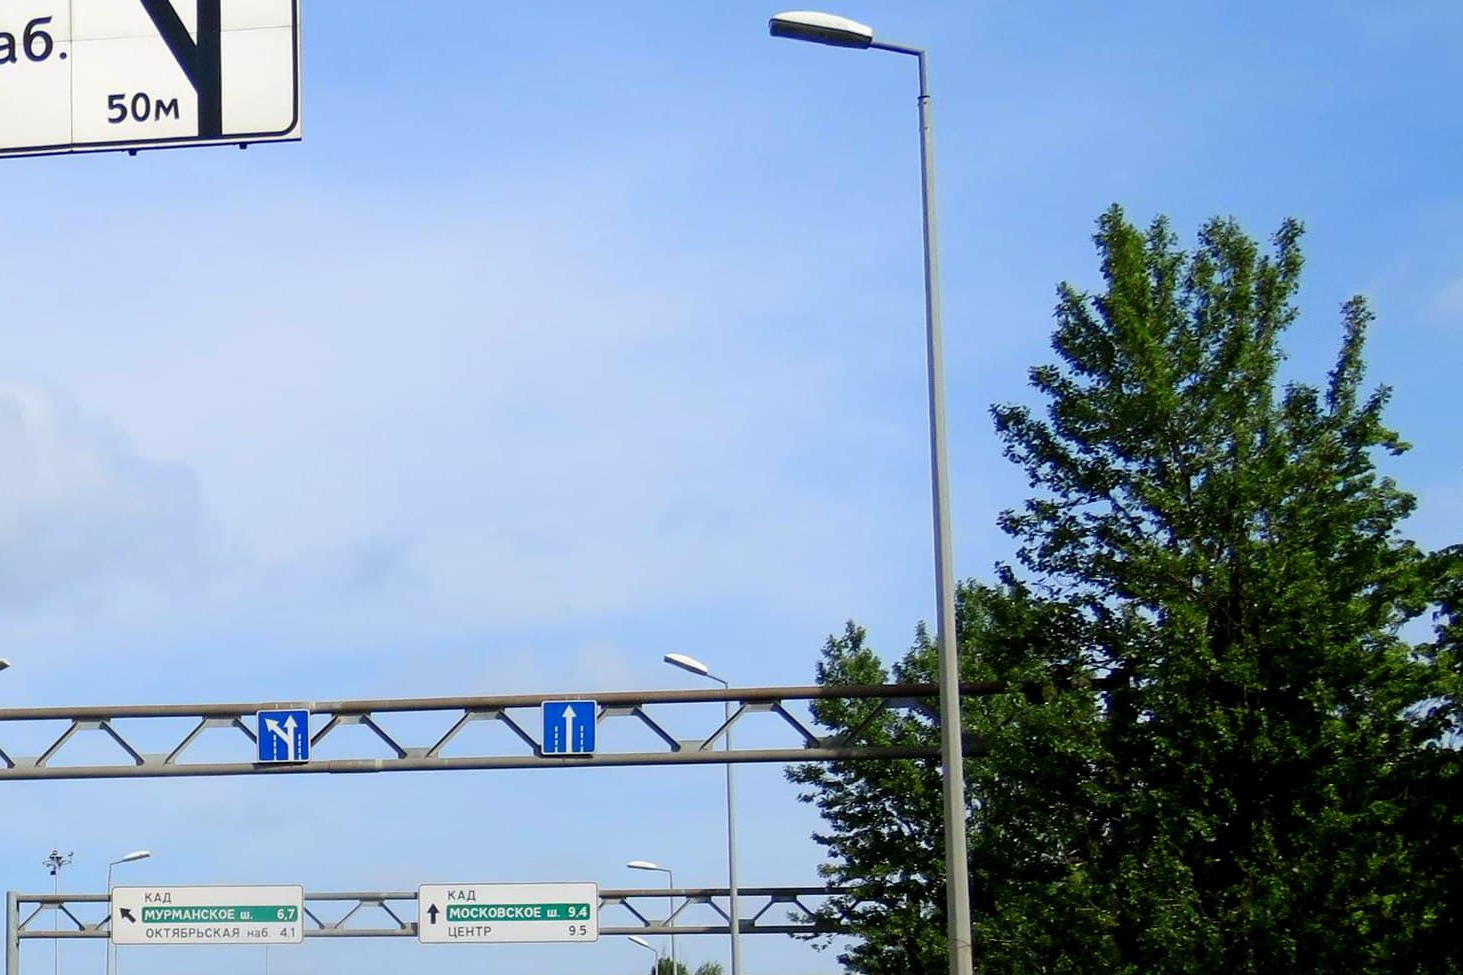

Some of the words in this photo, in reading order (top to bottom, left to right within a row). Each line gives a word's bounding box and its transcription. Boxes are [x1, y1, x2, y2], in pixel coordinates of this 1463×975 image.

[107, 92, 180, 124] 50м
[145, 892, 172, 904] КАД
[447, 890, 476, 901] КАД
[144, 908, 235, 921] МУРМАНСКОЕ
[240, 911, 254, 920] ш.
[277, 908, 296, 921] 6,7
[449, 906, 542, 919] МОСКОВСКОЕ
[546, 909, 561, 918] ш.
[568, 906, 588, 919] 9,4
[146, 927, 240, 939] ОКТЯБРЬСКАЯ
[247, 927, 271, 938] наб.
[448, 926, 492, 939] ЦЕНТР
